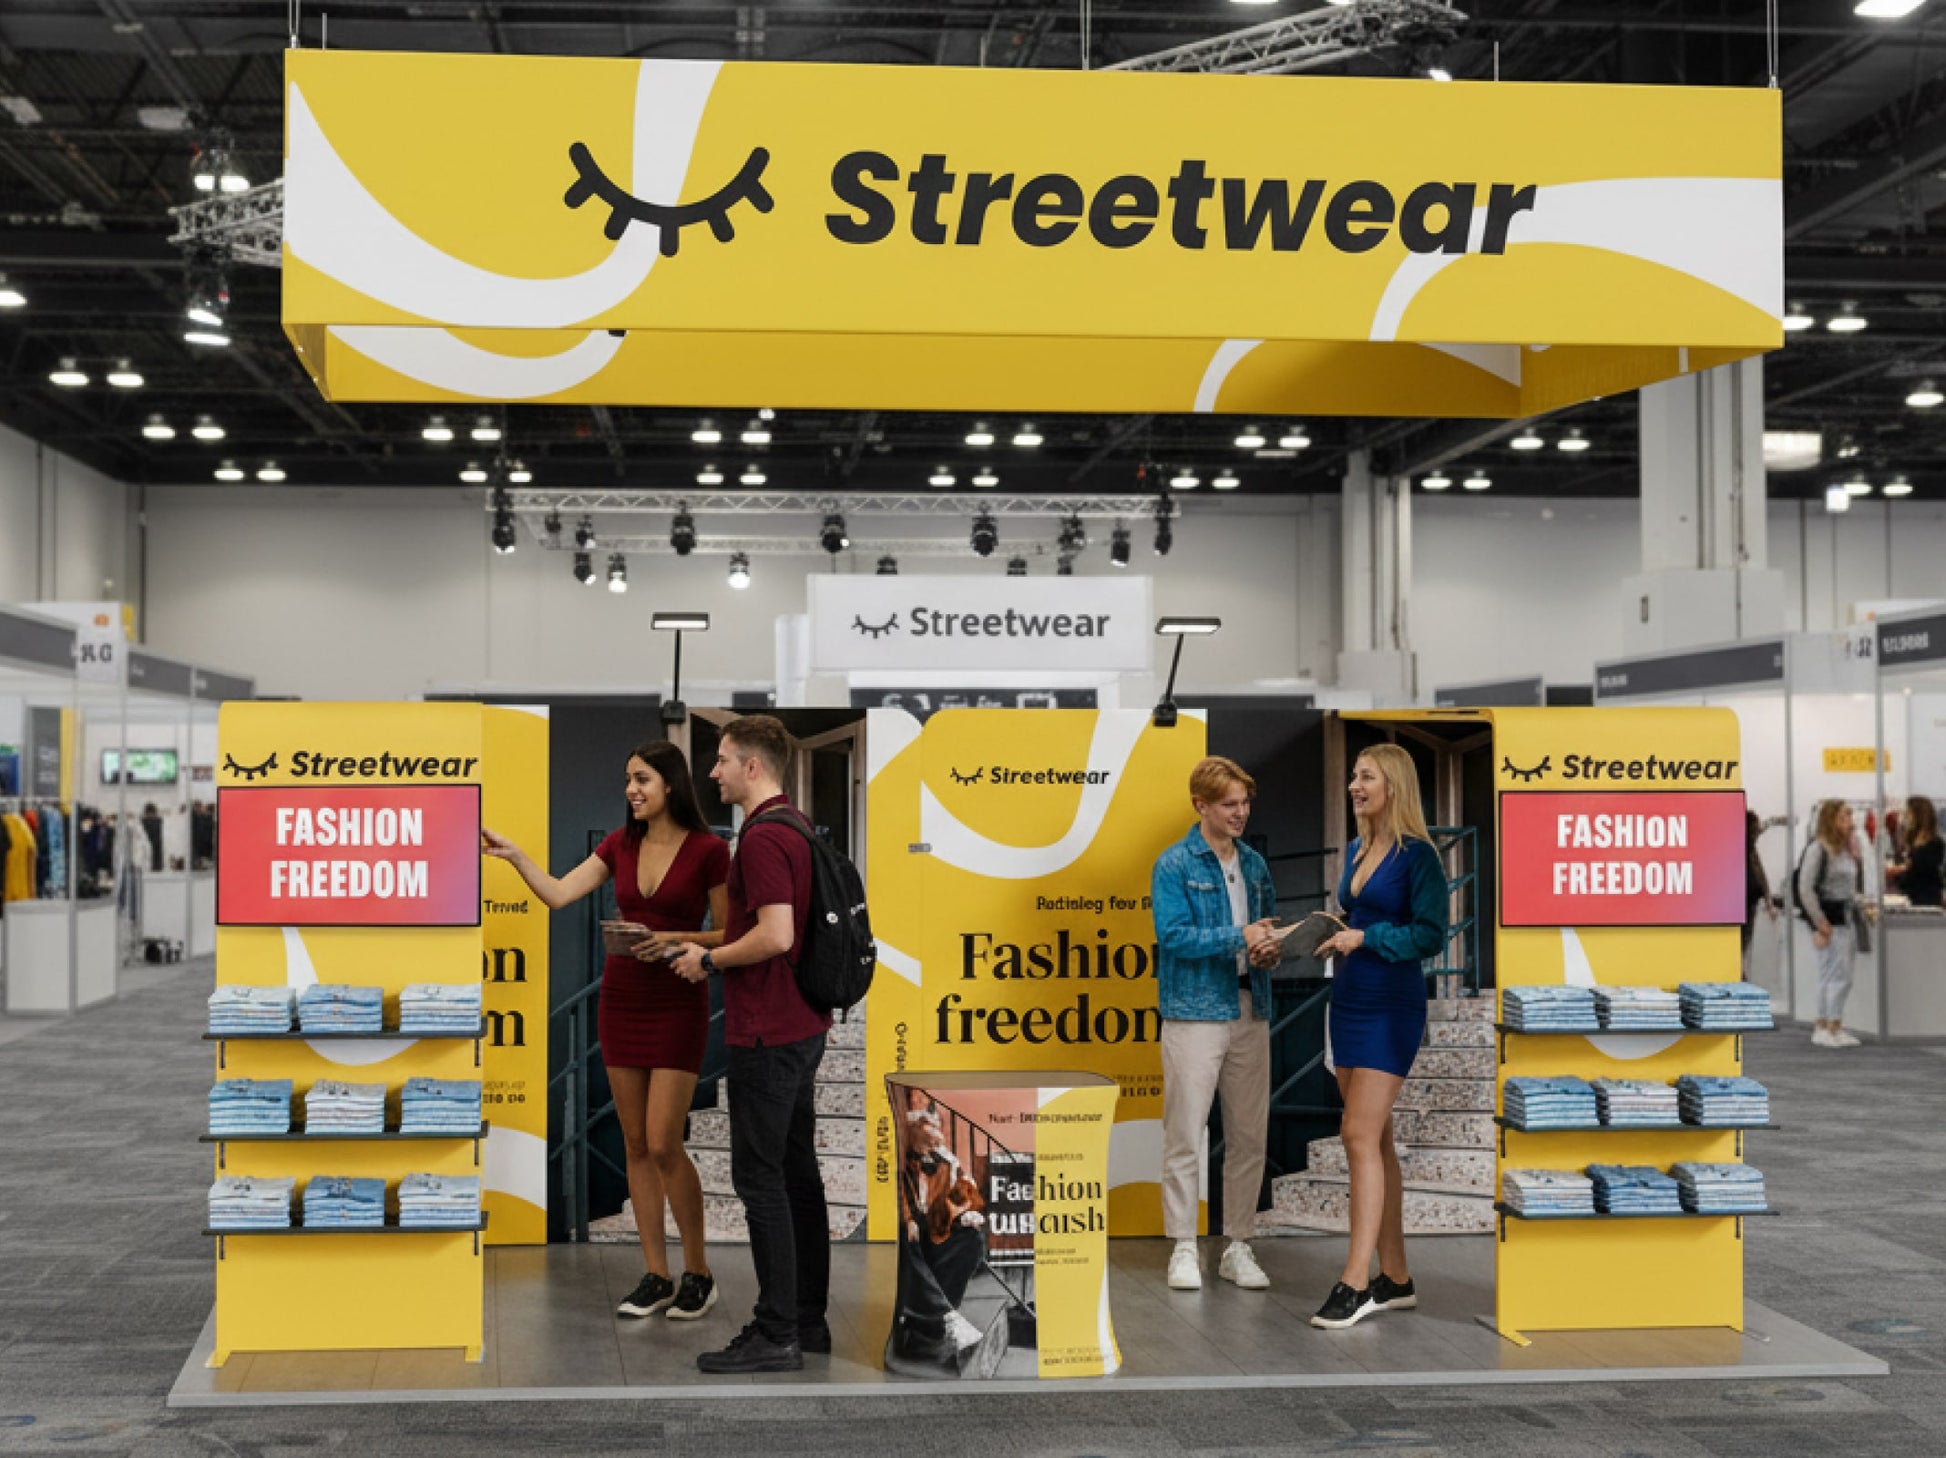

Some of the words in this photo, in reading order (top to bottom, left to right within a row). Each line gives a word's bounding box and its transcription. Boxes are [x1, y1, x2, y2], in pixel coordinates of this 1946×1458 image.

[825, 151, 1537, 256] Streetwear
[910, 606, 1111, 637] Streetwear
[290, 750, 478, 778] Streetwear
[1561, 754, 1739, 780] Streetwear
[277, 807, 423, 846] FASHION
[1557, 814, 1687, 848] FASHION
[271, 860, 427, 898] FREEDOM
[1553, 862, 1692, 895] FREEDOM
[960, 928, 1159, 980] Fashio
